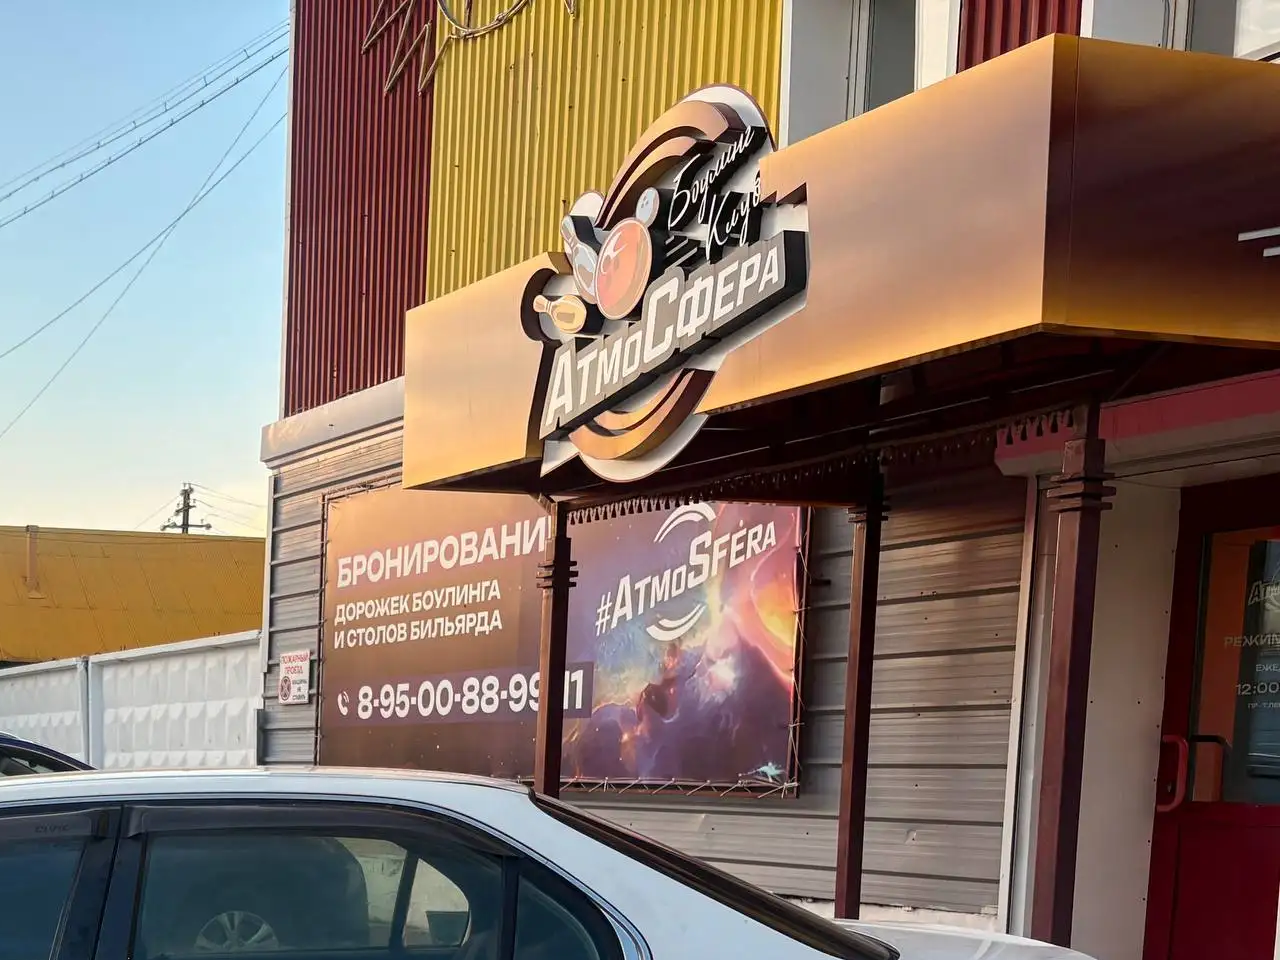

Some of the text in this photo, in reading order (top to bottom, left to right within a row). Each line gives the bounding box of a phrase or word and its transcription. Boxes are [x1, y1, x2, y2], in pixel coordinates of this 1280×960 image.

[668, 125, 755, 231] Боулинг
[336, 515, 552, 588] БРОНИРОВАНИ
[333, 579, 502, 626] ДОРОЖЕК БОУЛИНГА
[333, 609, 503, 649] И СТОЛОВ БИЛЬЯРДА
[357, 669, 585, 720] 8-95-00-88-9911
